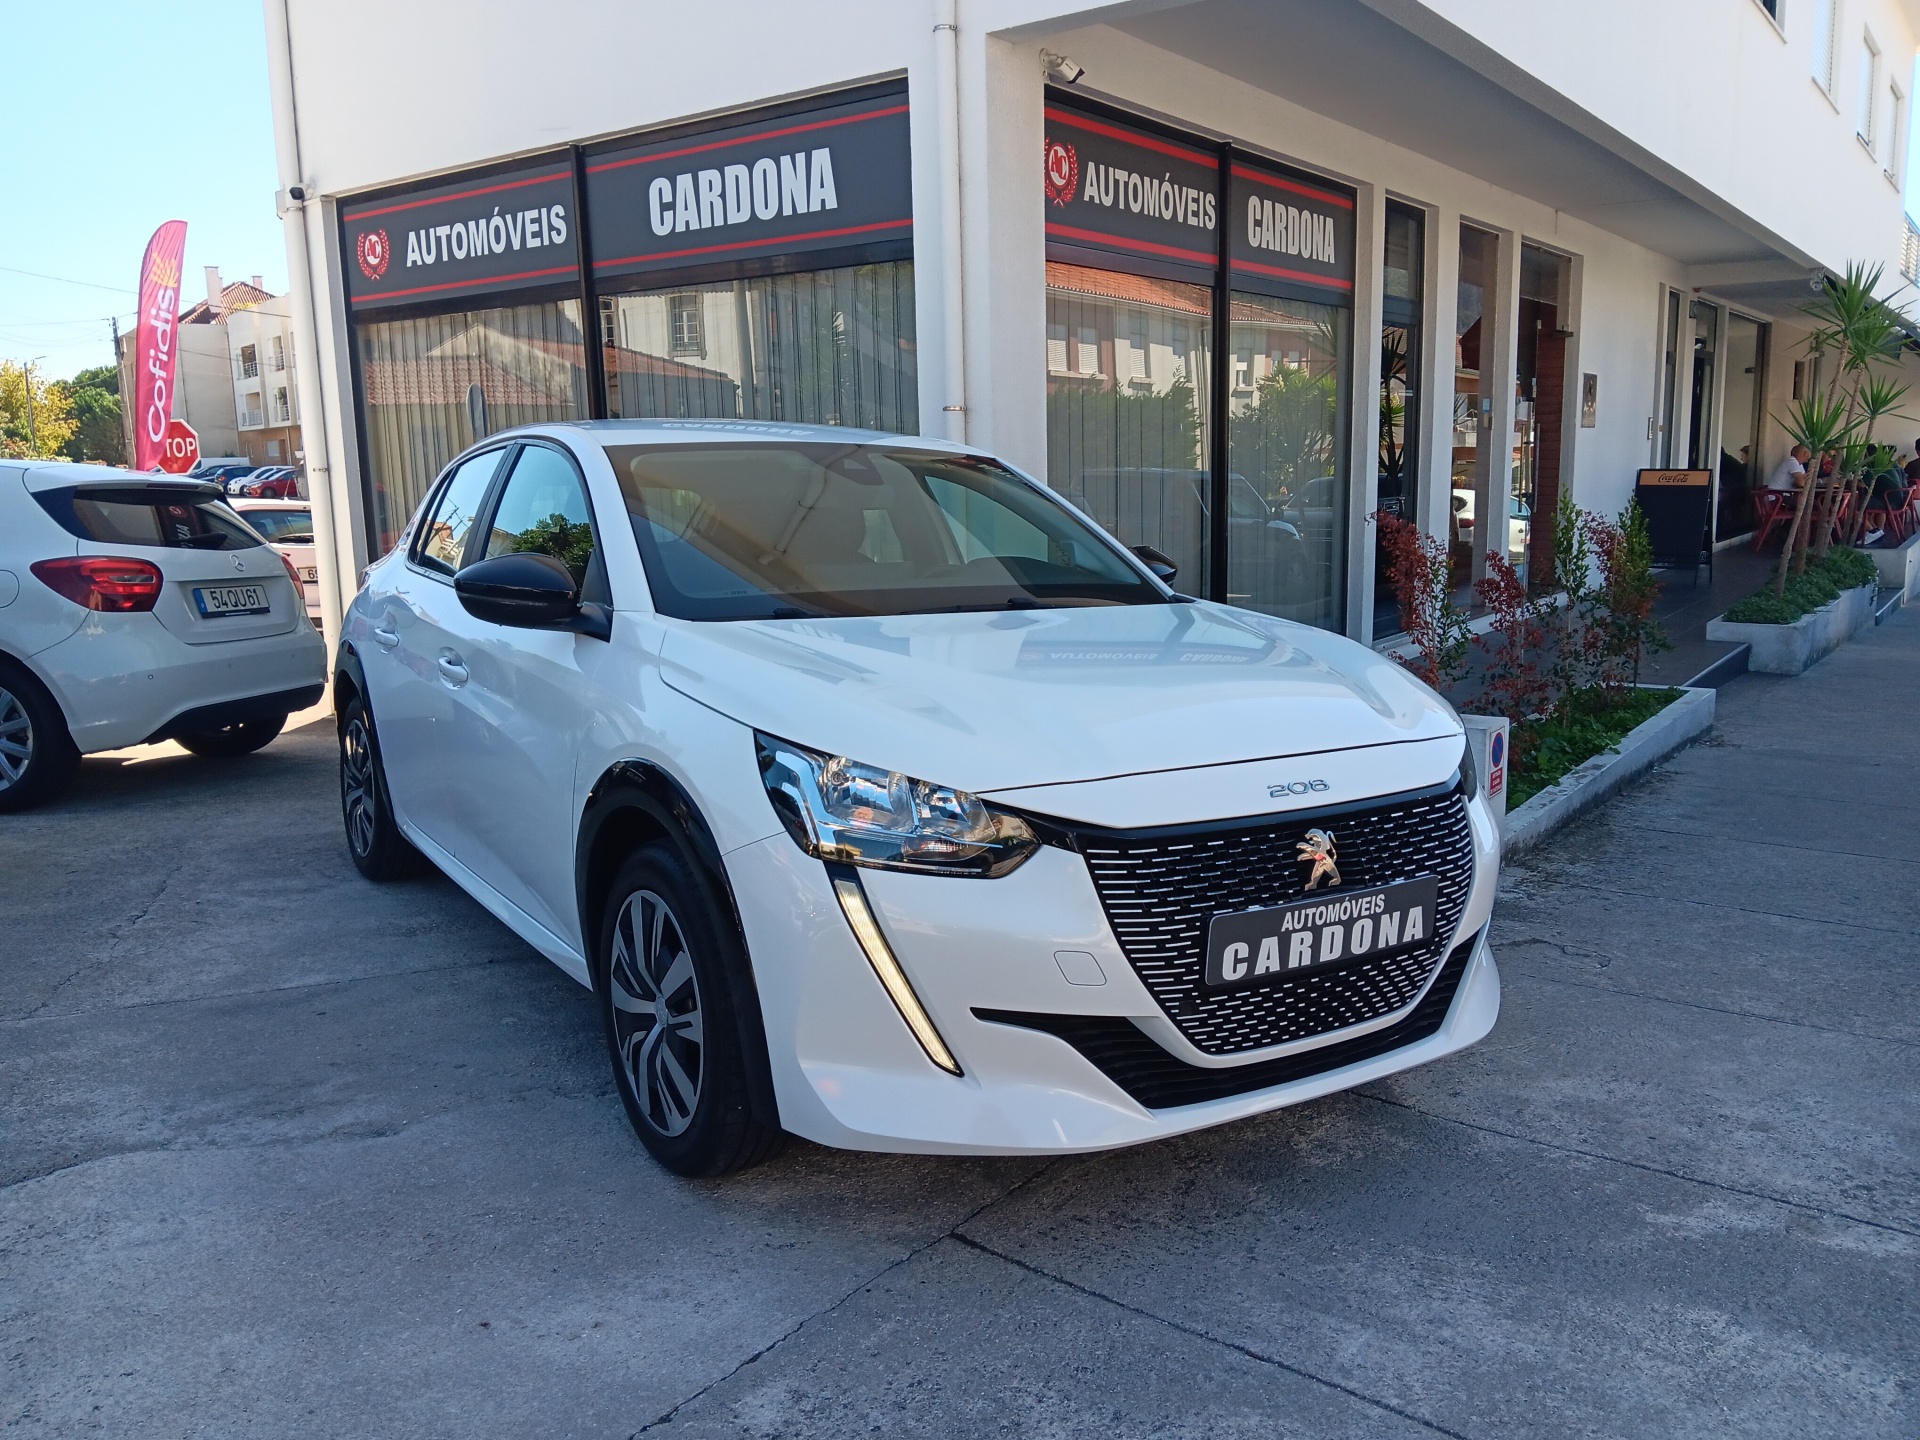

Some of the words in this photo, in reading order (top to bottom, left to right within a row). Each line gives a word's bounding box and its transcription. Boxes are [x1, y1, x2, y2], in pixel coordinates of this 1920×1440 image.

[405, 203, 568, 268] AUTOMÓVEIS
[648, 147, 839, 237] CARDONA
[1083, 161, 1216, 231] AUTOMÓVEIS
[1247, 195, 1335, 264] CARDONA
[166, 437, 196, 458] TOP
[209, 588, 261, 609] 54QU61
[1267, 779, 1330, 798] 208
[1281, 894, 1385, 931] AUTOMÓVEIS
[1222, 906, 1424, 981] CARDONA
